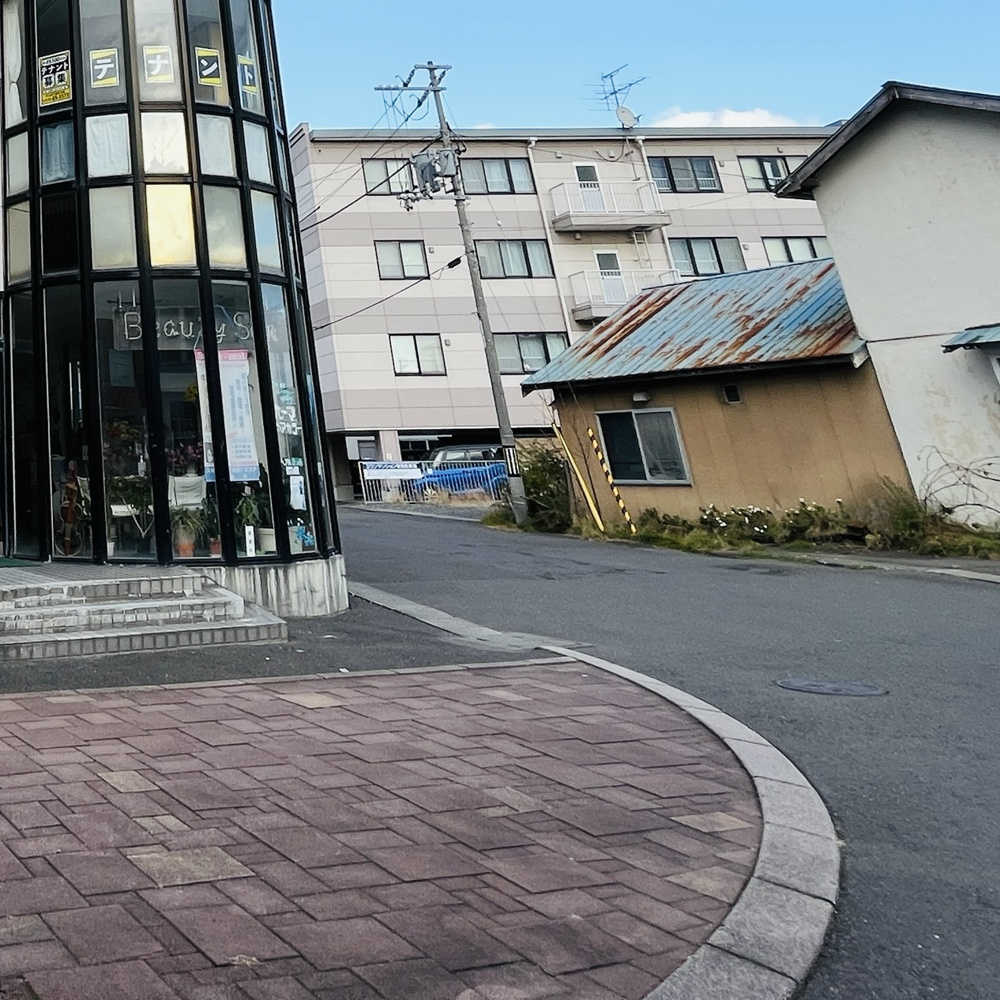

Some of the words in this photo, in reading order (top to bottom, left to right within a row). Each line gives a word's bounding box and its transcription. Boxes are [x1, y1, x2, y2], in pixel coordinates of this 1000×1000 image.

[41, 62, 69, 75] テナント
[43, 73, 67, 88] 募集
[124, 311, 227, 344] Bauy
